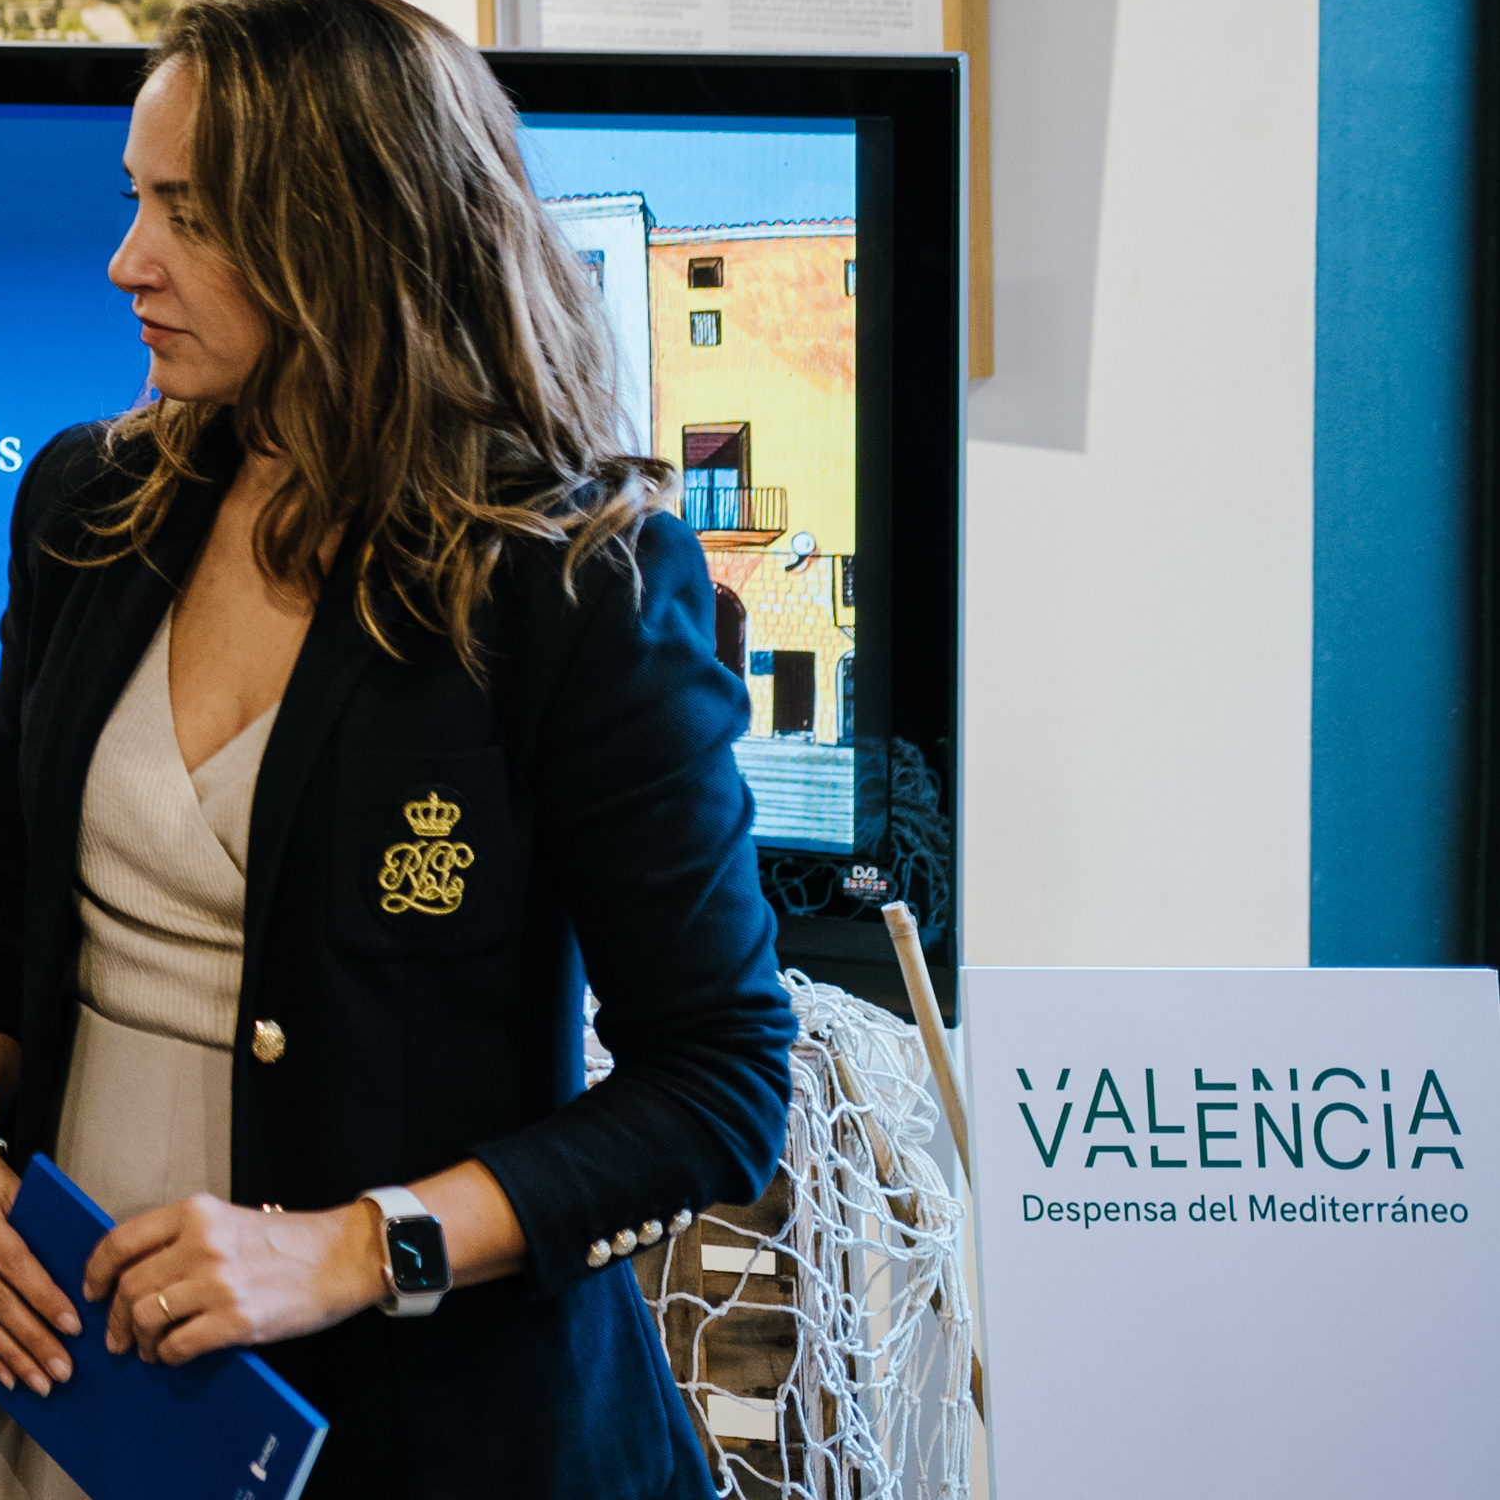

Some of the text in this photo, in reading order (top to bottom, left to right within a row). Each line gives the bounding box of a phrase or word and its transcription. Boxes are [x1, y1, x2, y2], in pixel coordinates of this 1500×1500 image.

[1016, 1067, 1465, 1171] VALENCIA
[1022, 1194, 1469, 1229] Despensa del Mediterráneo
